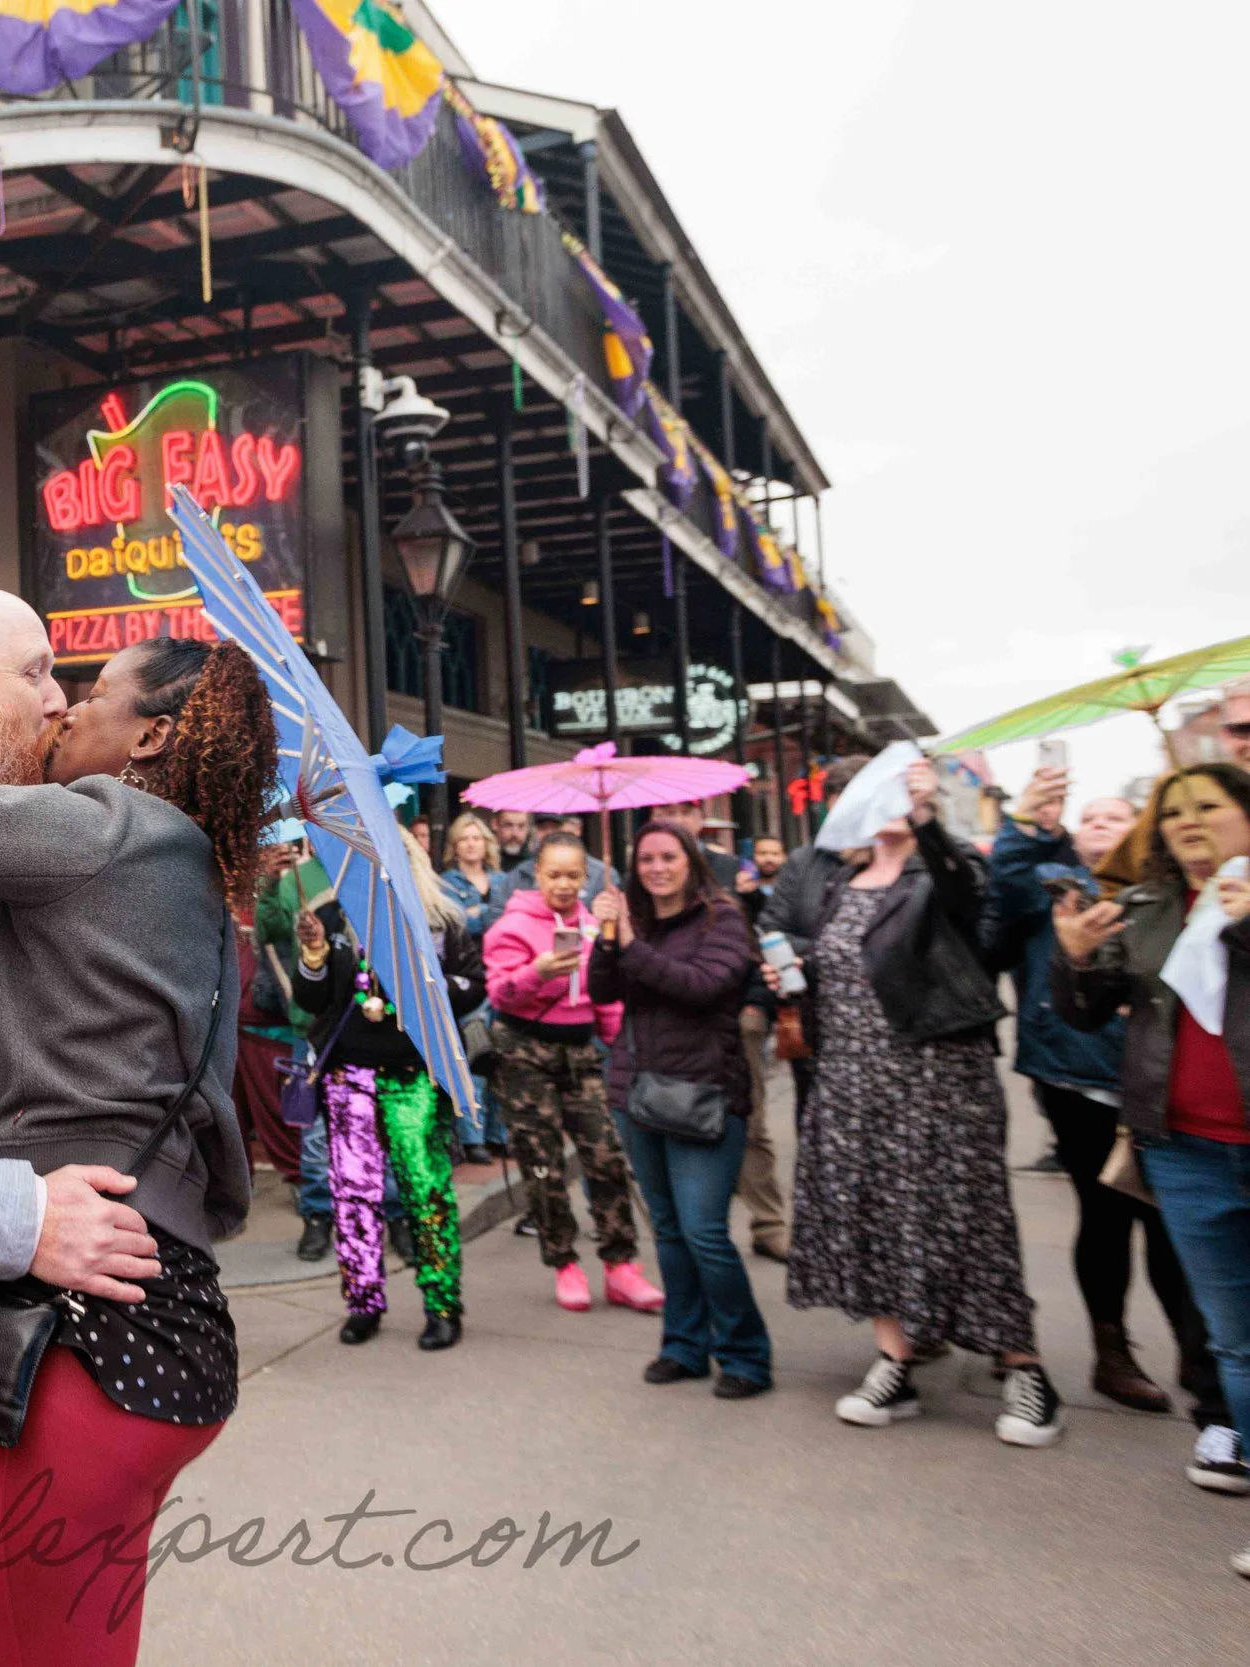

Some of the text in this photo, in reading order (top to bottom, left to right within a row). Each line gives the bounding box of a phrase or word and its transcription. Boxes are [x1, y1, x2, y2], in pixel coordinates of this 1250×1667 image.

[43, 429, 302, 531] BIG EASY
[51, 614, 121, 650] PIZZA
[125, 610, 162, 647] BY
